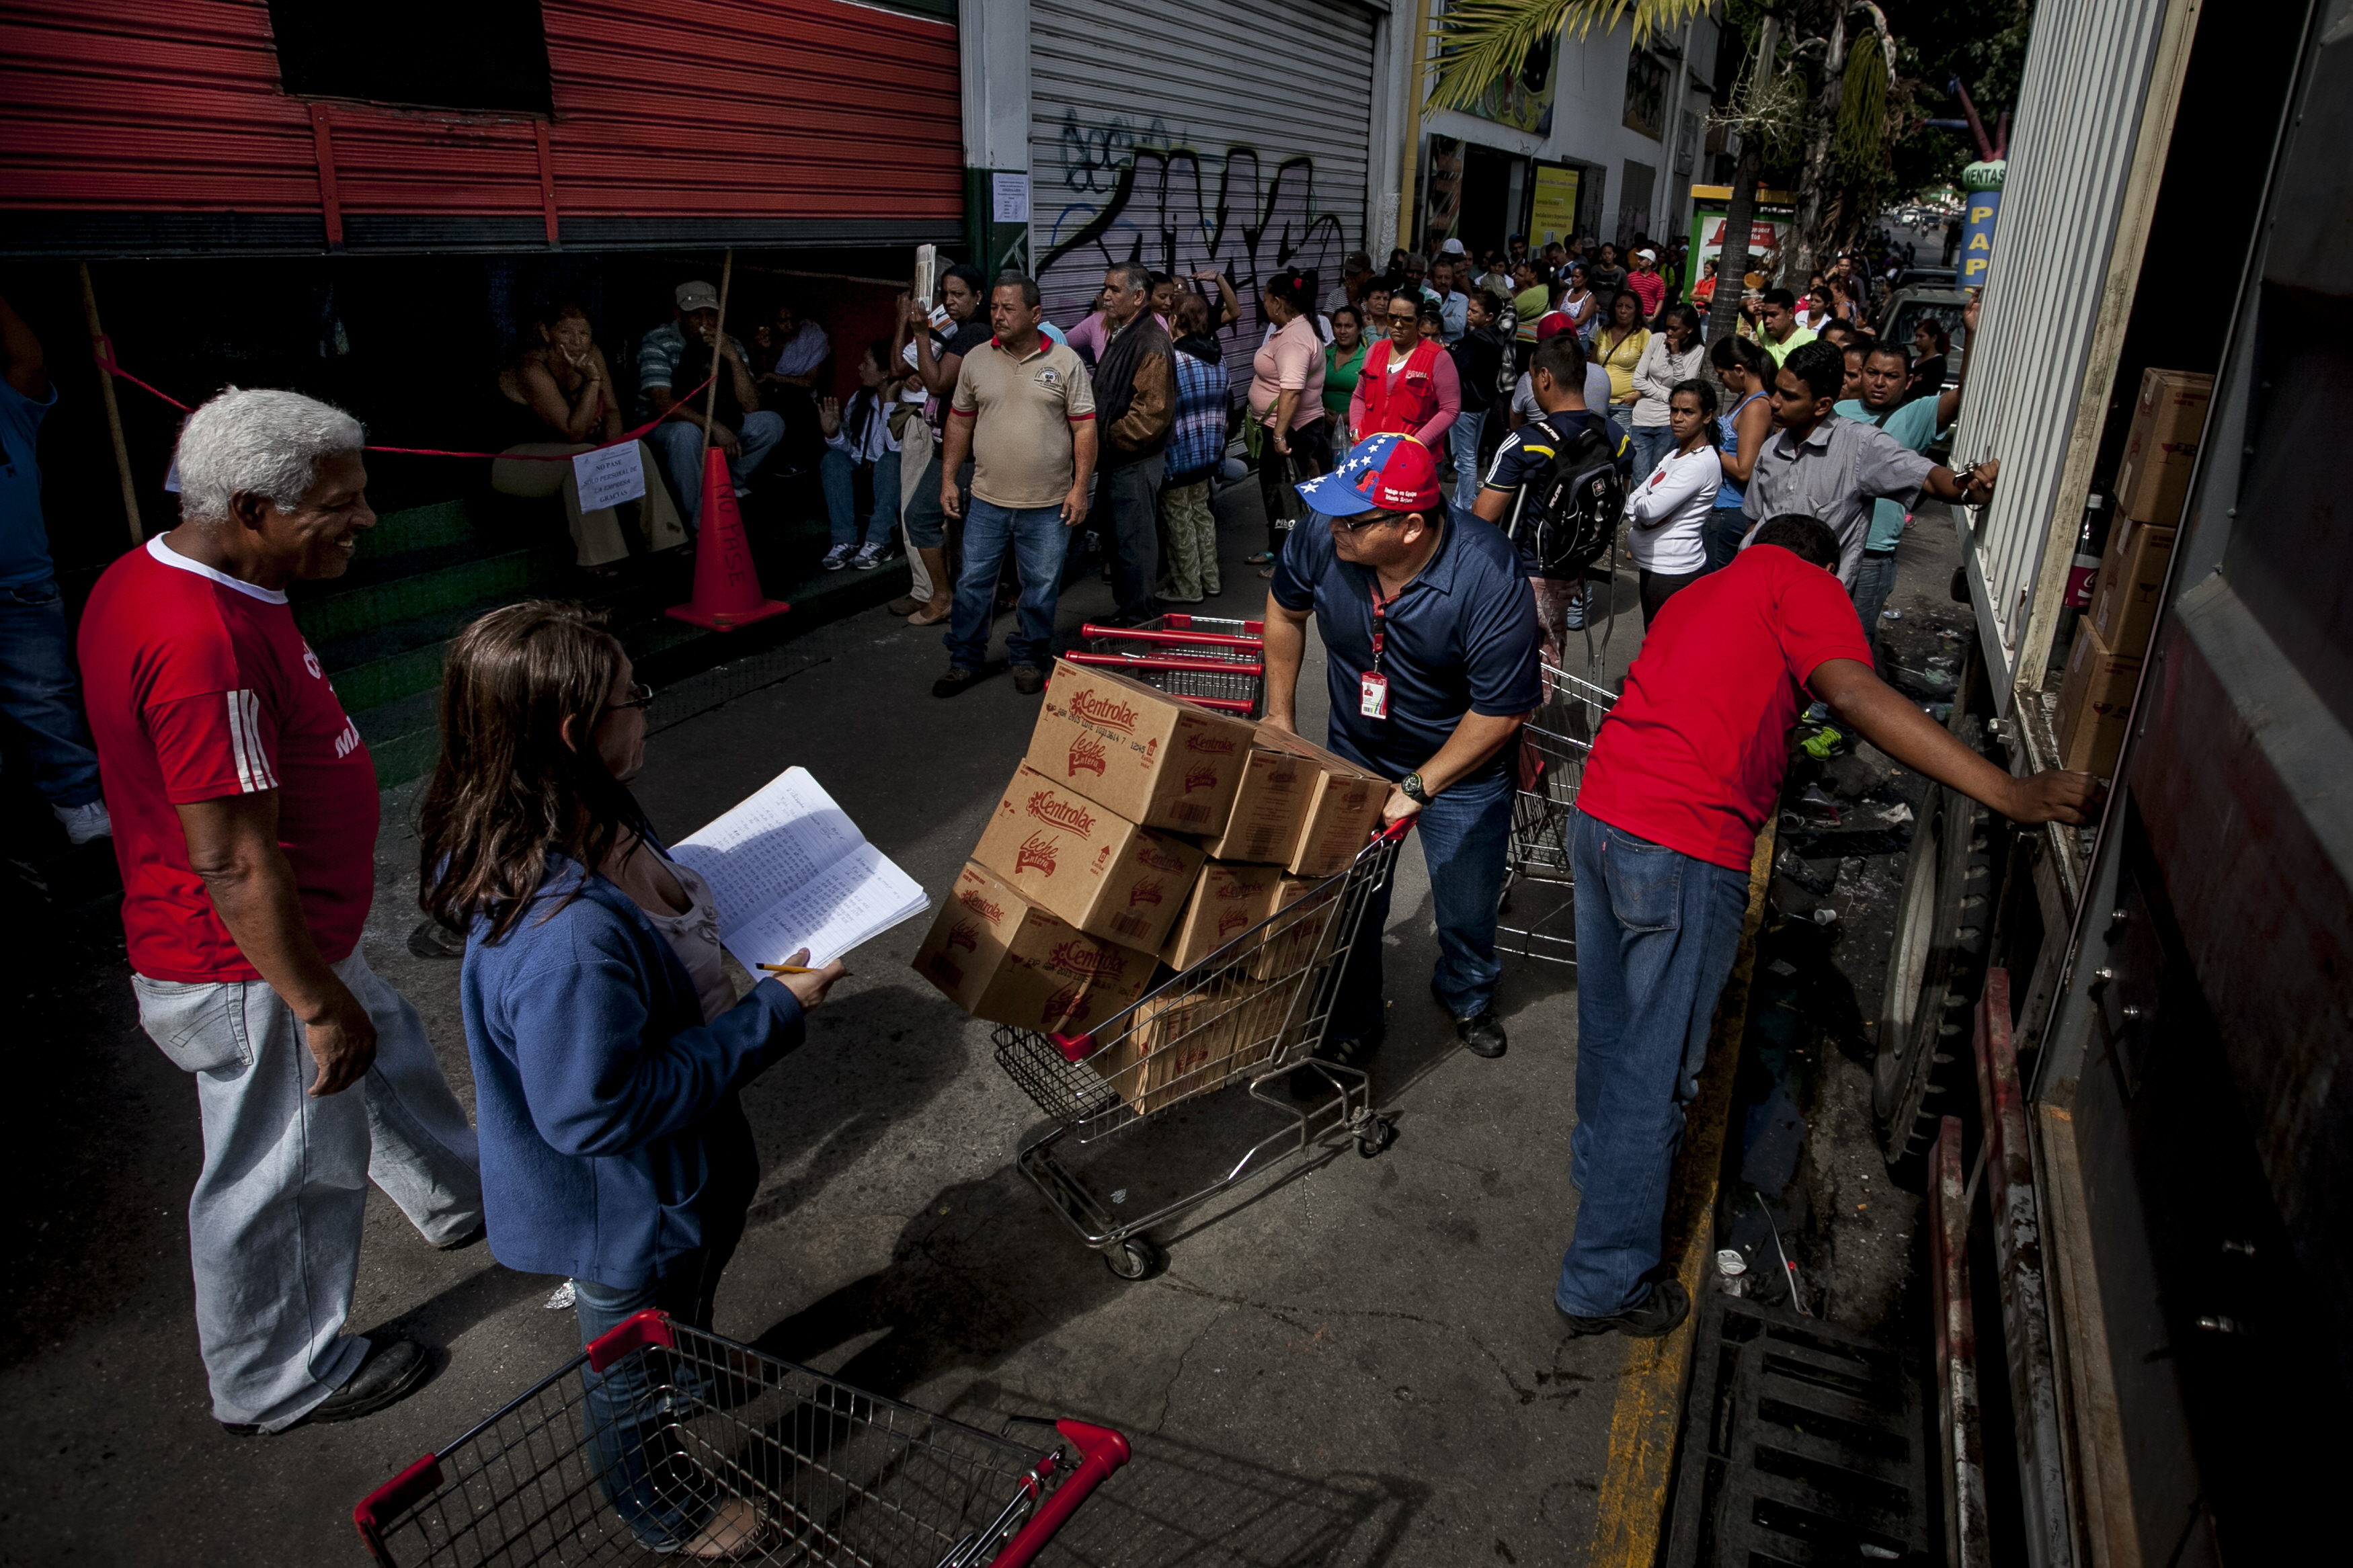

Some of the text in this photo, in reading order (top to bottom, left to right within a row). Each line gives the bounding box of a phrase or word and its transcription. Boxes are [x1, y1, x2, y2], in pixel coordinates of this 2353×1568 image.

[1966, 169, 2005, 184] VENTAS
[2178, 442, 2196, 452] EXP
[606, 459, 622, 468] PASE
[713, 483, 748, 587] NO PASE
[1081, 689, 1138, 728] Centrolac
[1069, 729, 1106, 758] Leche
[1195, 733, 1237, 752] Centrolac
[1073, 752, 1099, 768] Entera
[1039, 790, 1096, 833] Centrolac
[1020, 829, 1059, 858] Leche
[1022, 852, 1049, 868] Entera
[1147, 848, 1187, 873] Centrolac
[969, 890, 1004, 921] Centrolac
[1066, 940, 1128, 974] Centrolac
